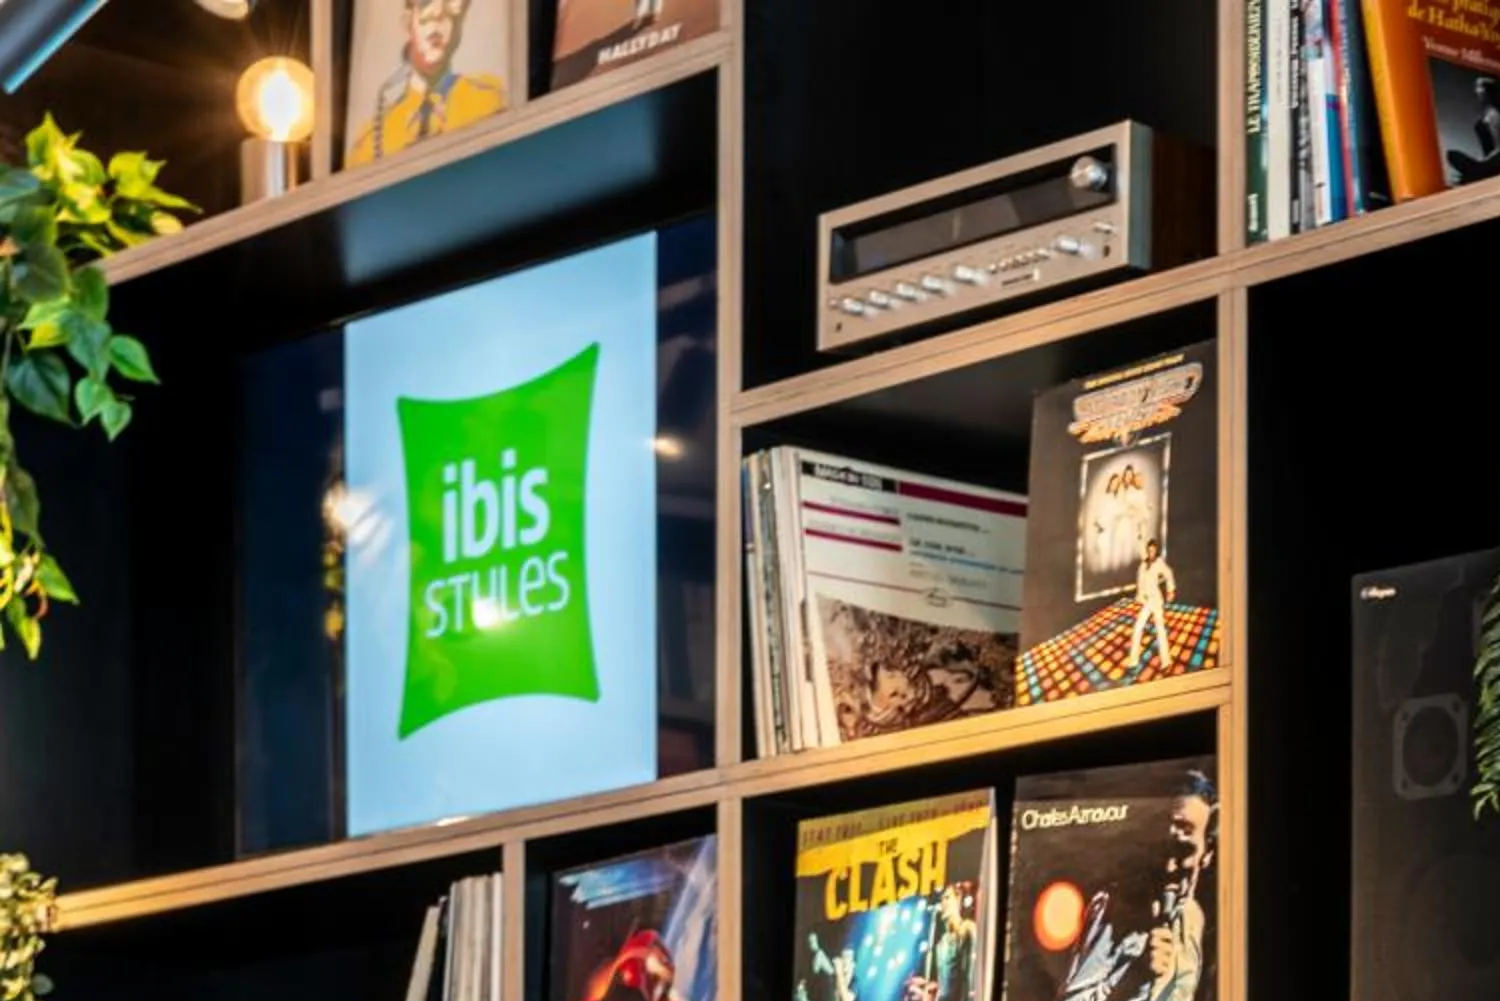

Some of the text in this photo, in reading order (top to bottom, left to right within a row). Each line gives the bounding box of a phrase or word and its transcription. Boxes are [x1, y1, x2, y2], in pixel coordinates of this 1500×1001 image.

[598, 22, 682, 64] HALLYDAY
[441, 448, 551, 564] ibis
[878, 838, 899, 857] THE
[825, 840, 947, 920] CLASH
